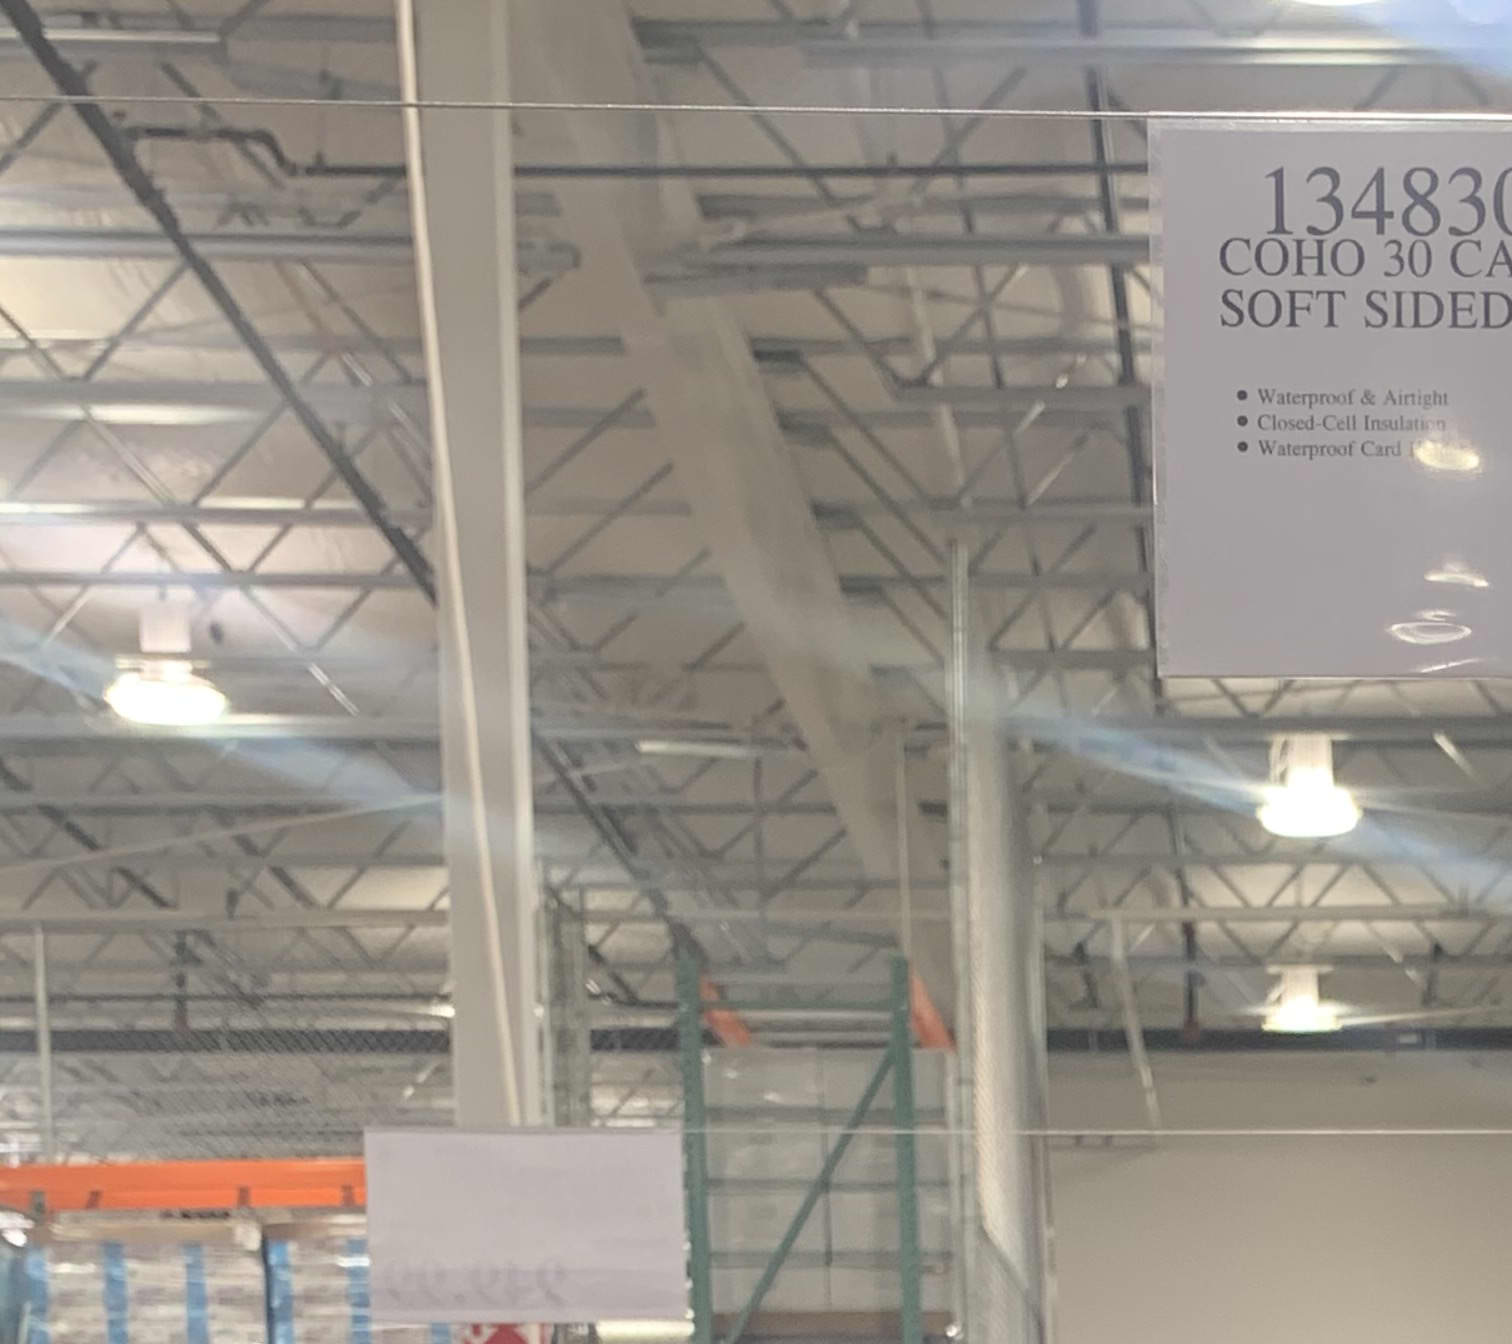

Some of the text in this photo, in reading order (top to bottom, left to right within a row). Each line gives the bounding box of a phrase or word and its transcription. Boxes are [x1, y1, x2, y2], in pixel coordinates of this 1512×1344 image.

[1219, 237, 1365, 278] COHO
[1383, 238, 1433, 278] 30
[1220, 289, 1346, 329] SOFT
[1257, 388, 1449, 411] Waterproof & Airtight
[1257, 414, 1447, 432] Closed-Cell Insulation
[1257, 439, 1354, 460] Waterproof
[1360, 440, 1402, 458] Card
